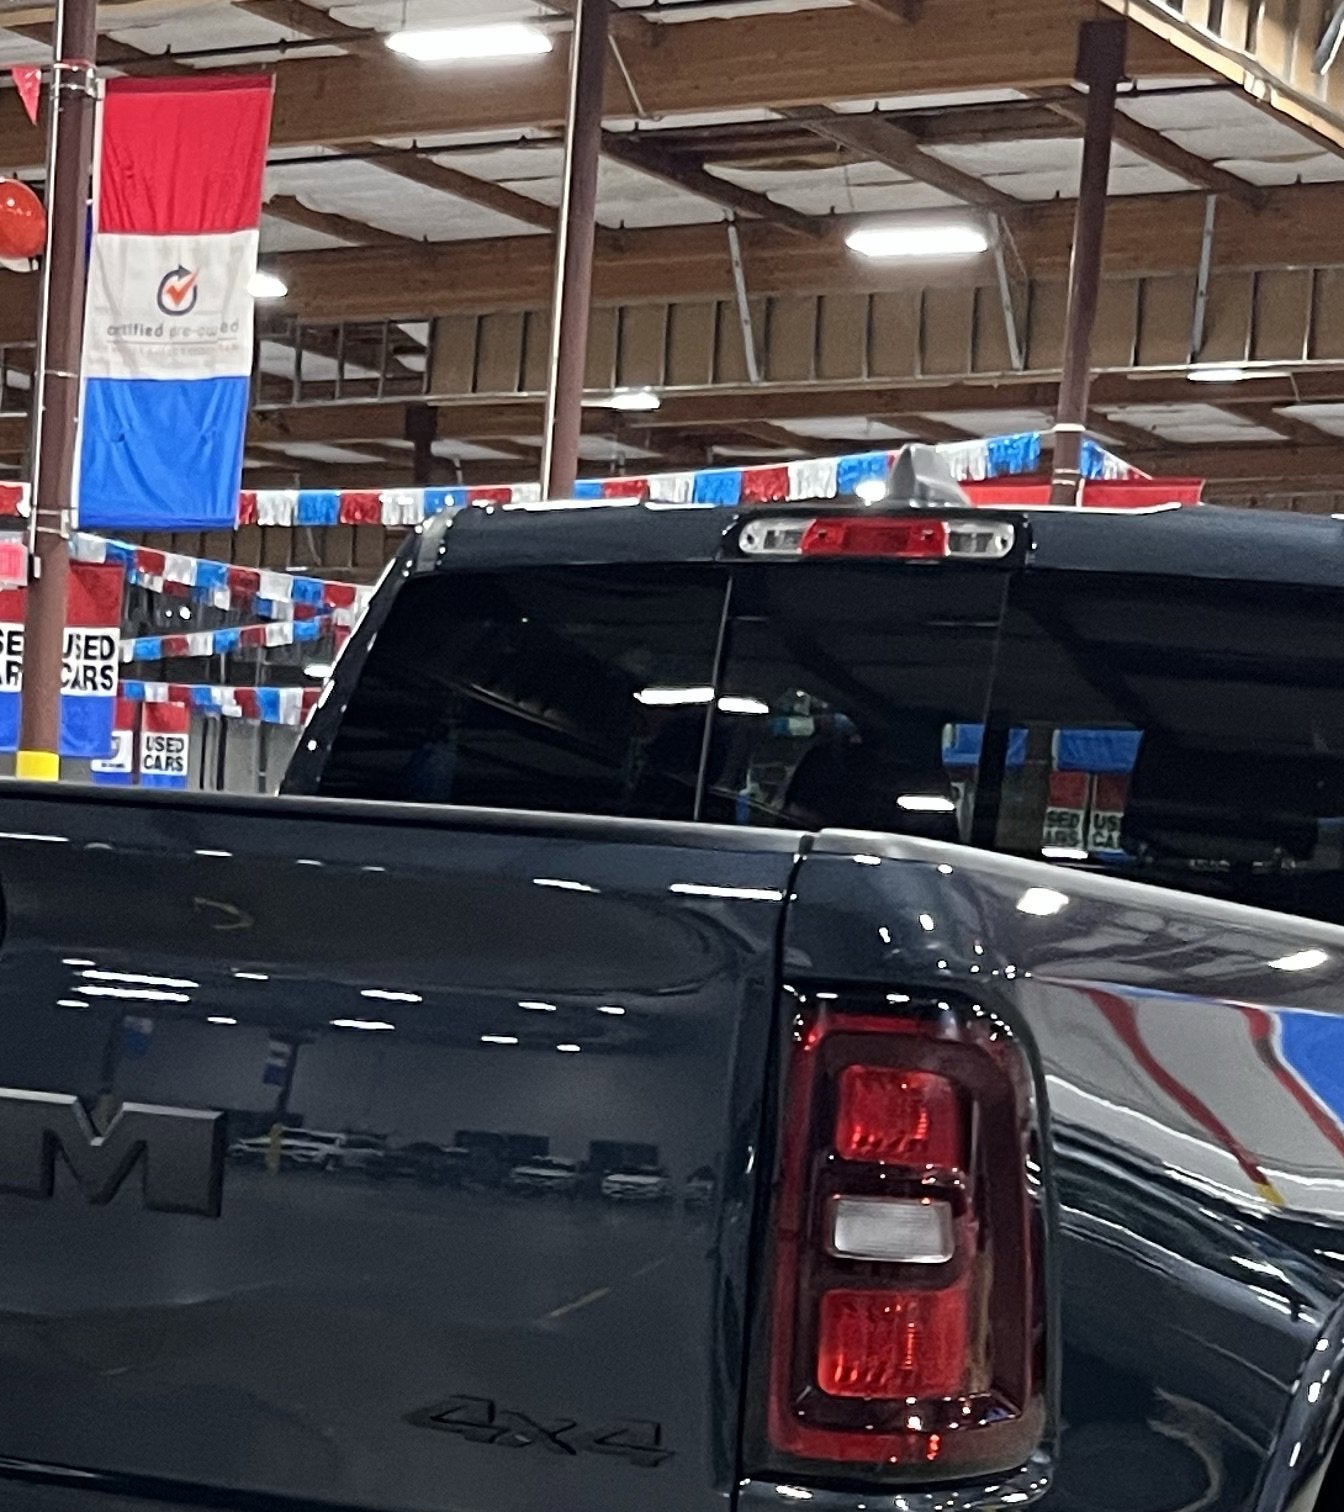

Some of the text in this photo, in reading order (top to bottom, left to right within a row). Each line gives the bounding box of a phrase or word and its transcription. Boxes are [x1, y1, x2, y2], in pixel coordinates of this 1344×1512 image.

[169, 321, 239, 337] pre-owed
[145, 735, 185, 753] USED
[143, 754, 184, 772] CARS
